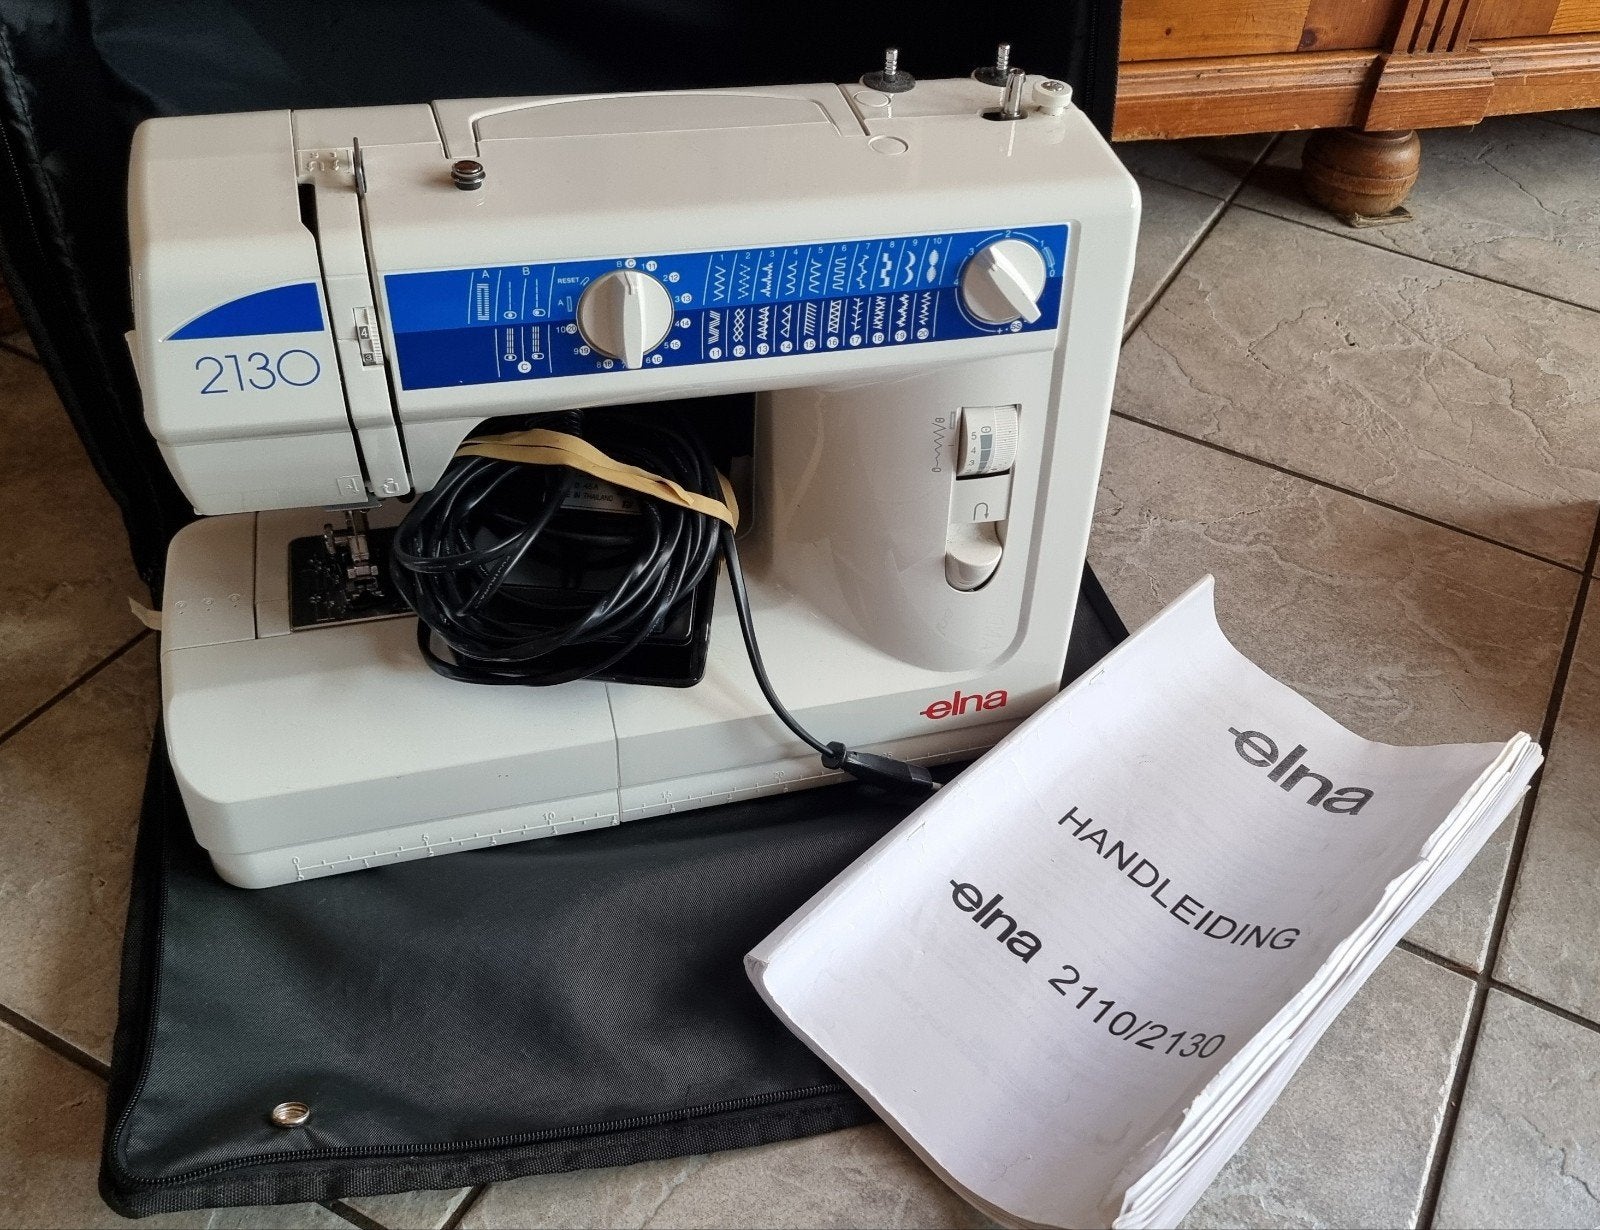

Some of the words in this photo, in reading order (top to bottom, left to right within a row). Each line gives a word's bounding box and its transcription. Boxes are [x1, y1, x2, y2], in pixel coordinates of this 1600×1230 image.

[1005, 230, 1011, 238] 2
[481, 270, 490, 278] A
[522, 266, 530, 276] B
[557, 276, 580, 284] RESET
[195, 350, 321, 395] 2130
[971, 431, 977, 440] 5
[920, 690, 1008, 720] elna
[1228, 726, 1375, 816] elna
[1057, 805, 1301, 951] HANDLEIDING
[949, 879, 1043, 964] elna
[1047, 964, 1227, 1059] 2110/2130
